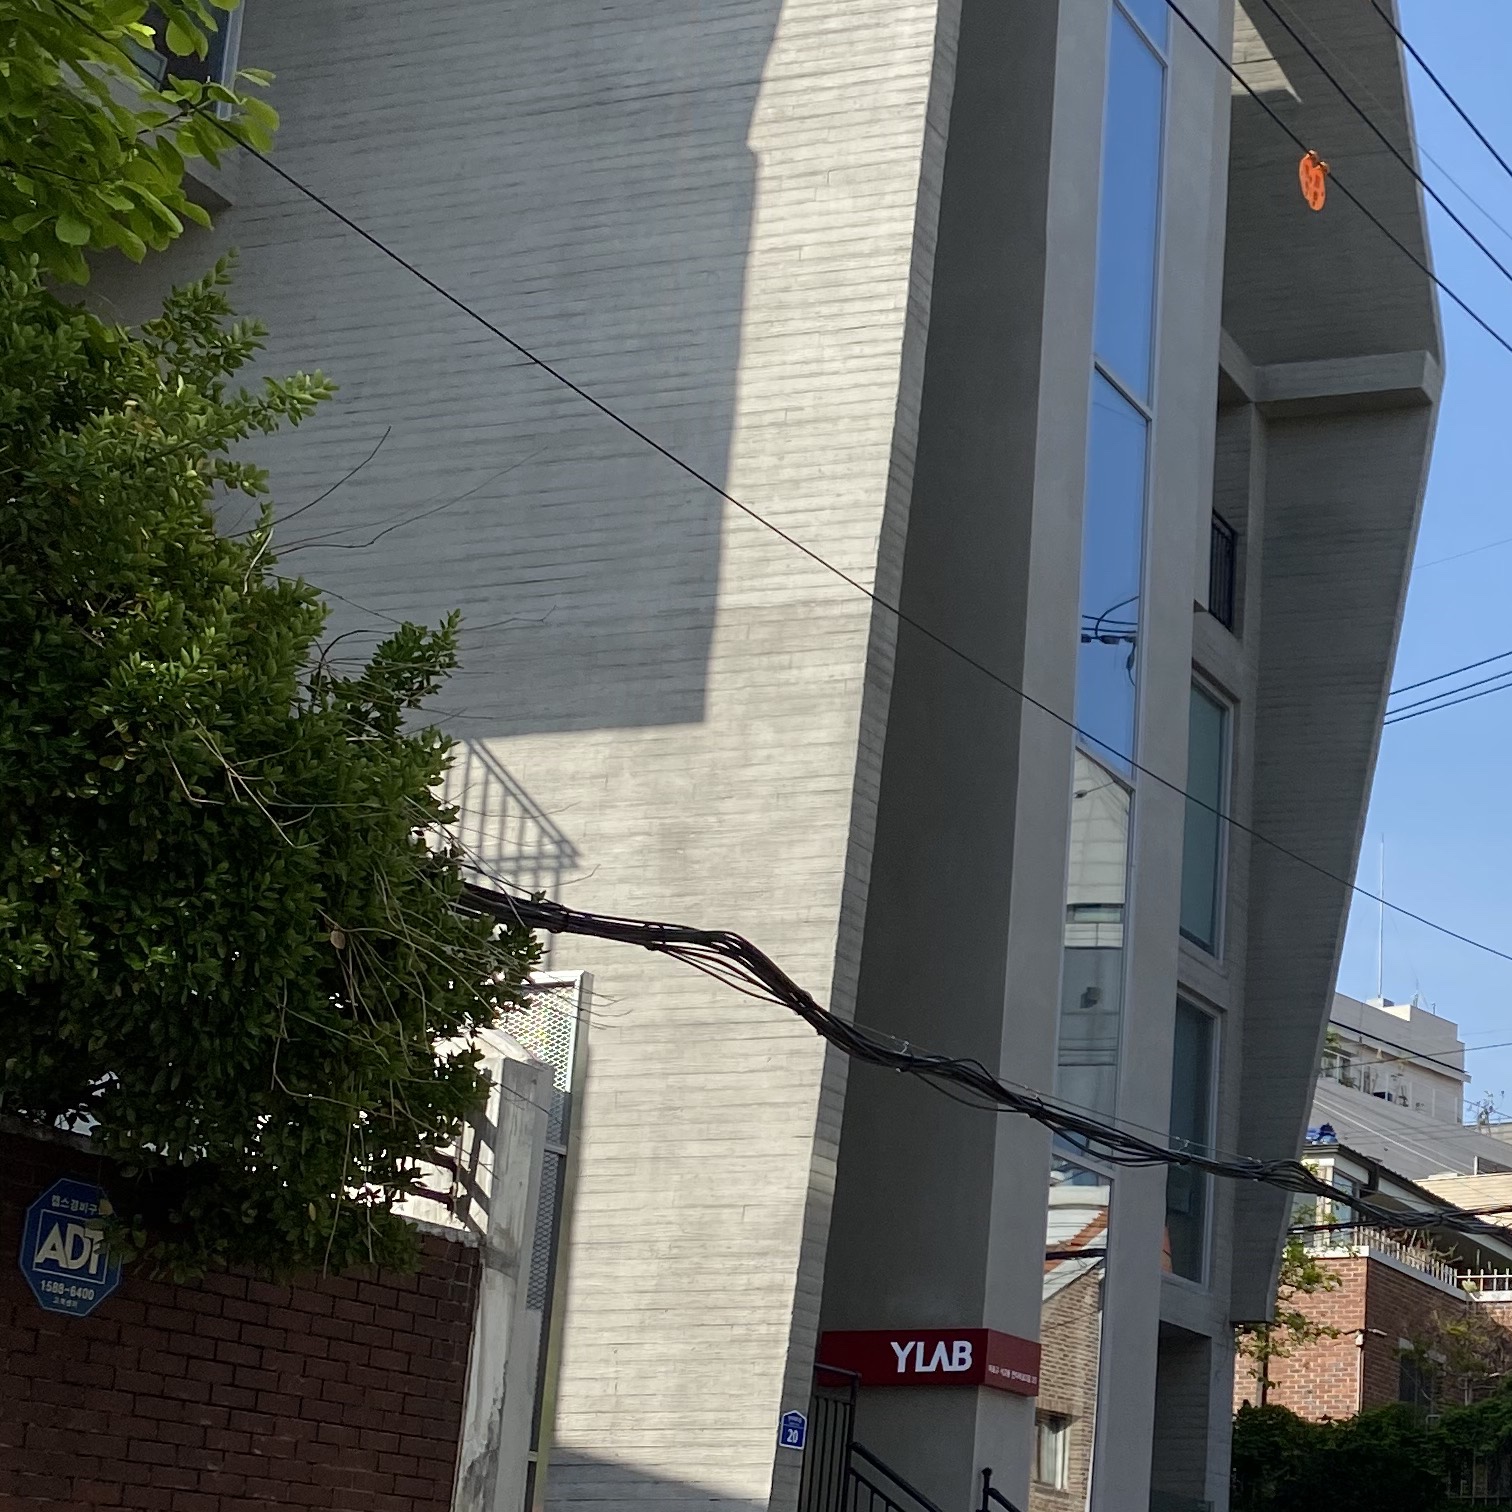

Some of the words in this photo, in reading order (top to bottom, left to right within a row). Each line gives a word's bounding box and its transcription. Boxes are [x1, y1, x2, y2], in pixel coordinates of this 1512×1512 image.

[51, 1194, 99, 1216] 캡스경비구
[35, 1221, 104, 1275] ADT
[890, 1340, 973, 1373] YLAB
[786, 1428, 799, 1444] 20
